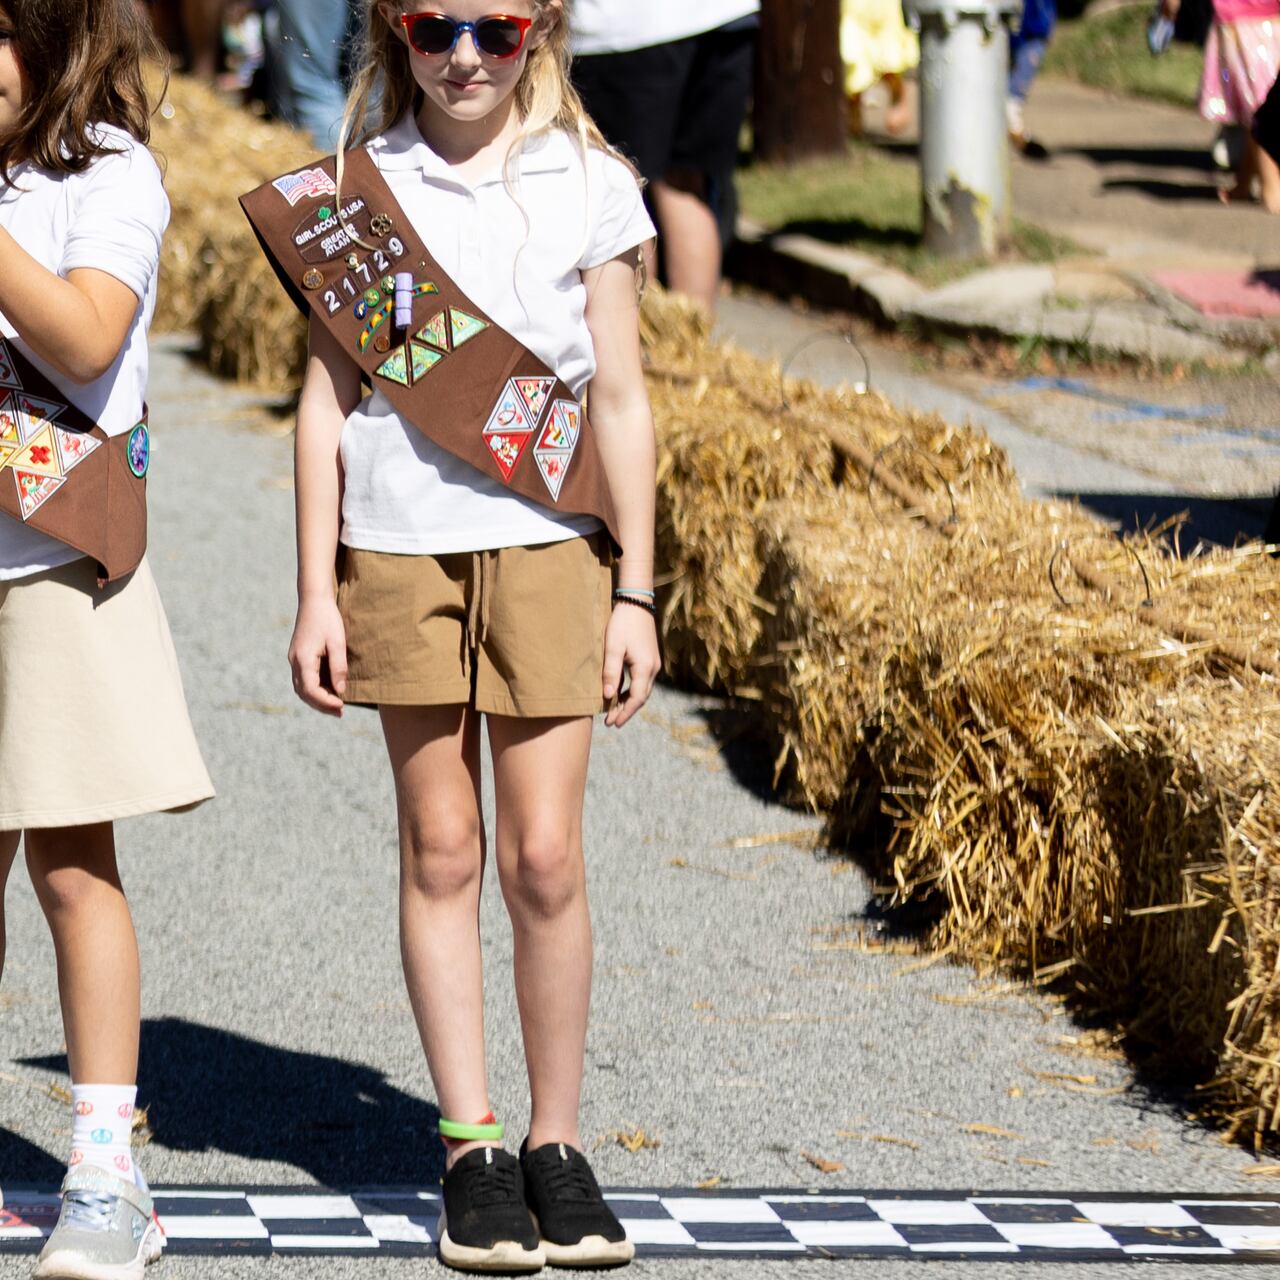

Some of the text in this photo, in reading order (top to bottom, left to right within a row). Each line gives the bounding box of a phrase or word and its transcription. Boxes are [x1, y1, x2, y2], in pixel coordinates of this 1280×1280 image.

[295, 199, 365, 246] GIRL SCOUS USA
